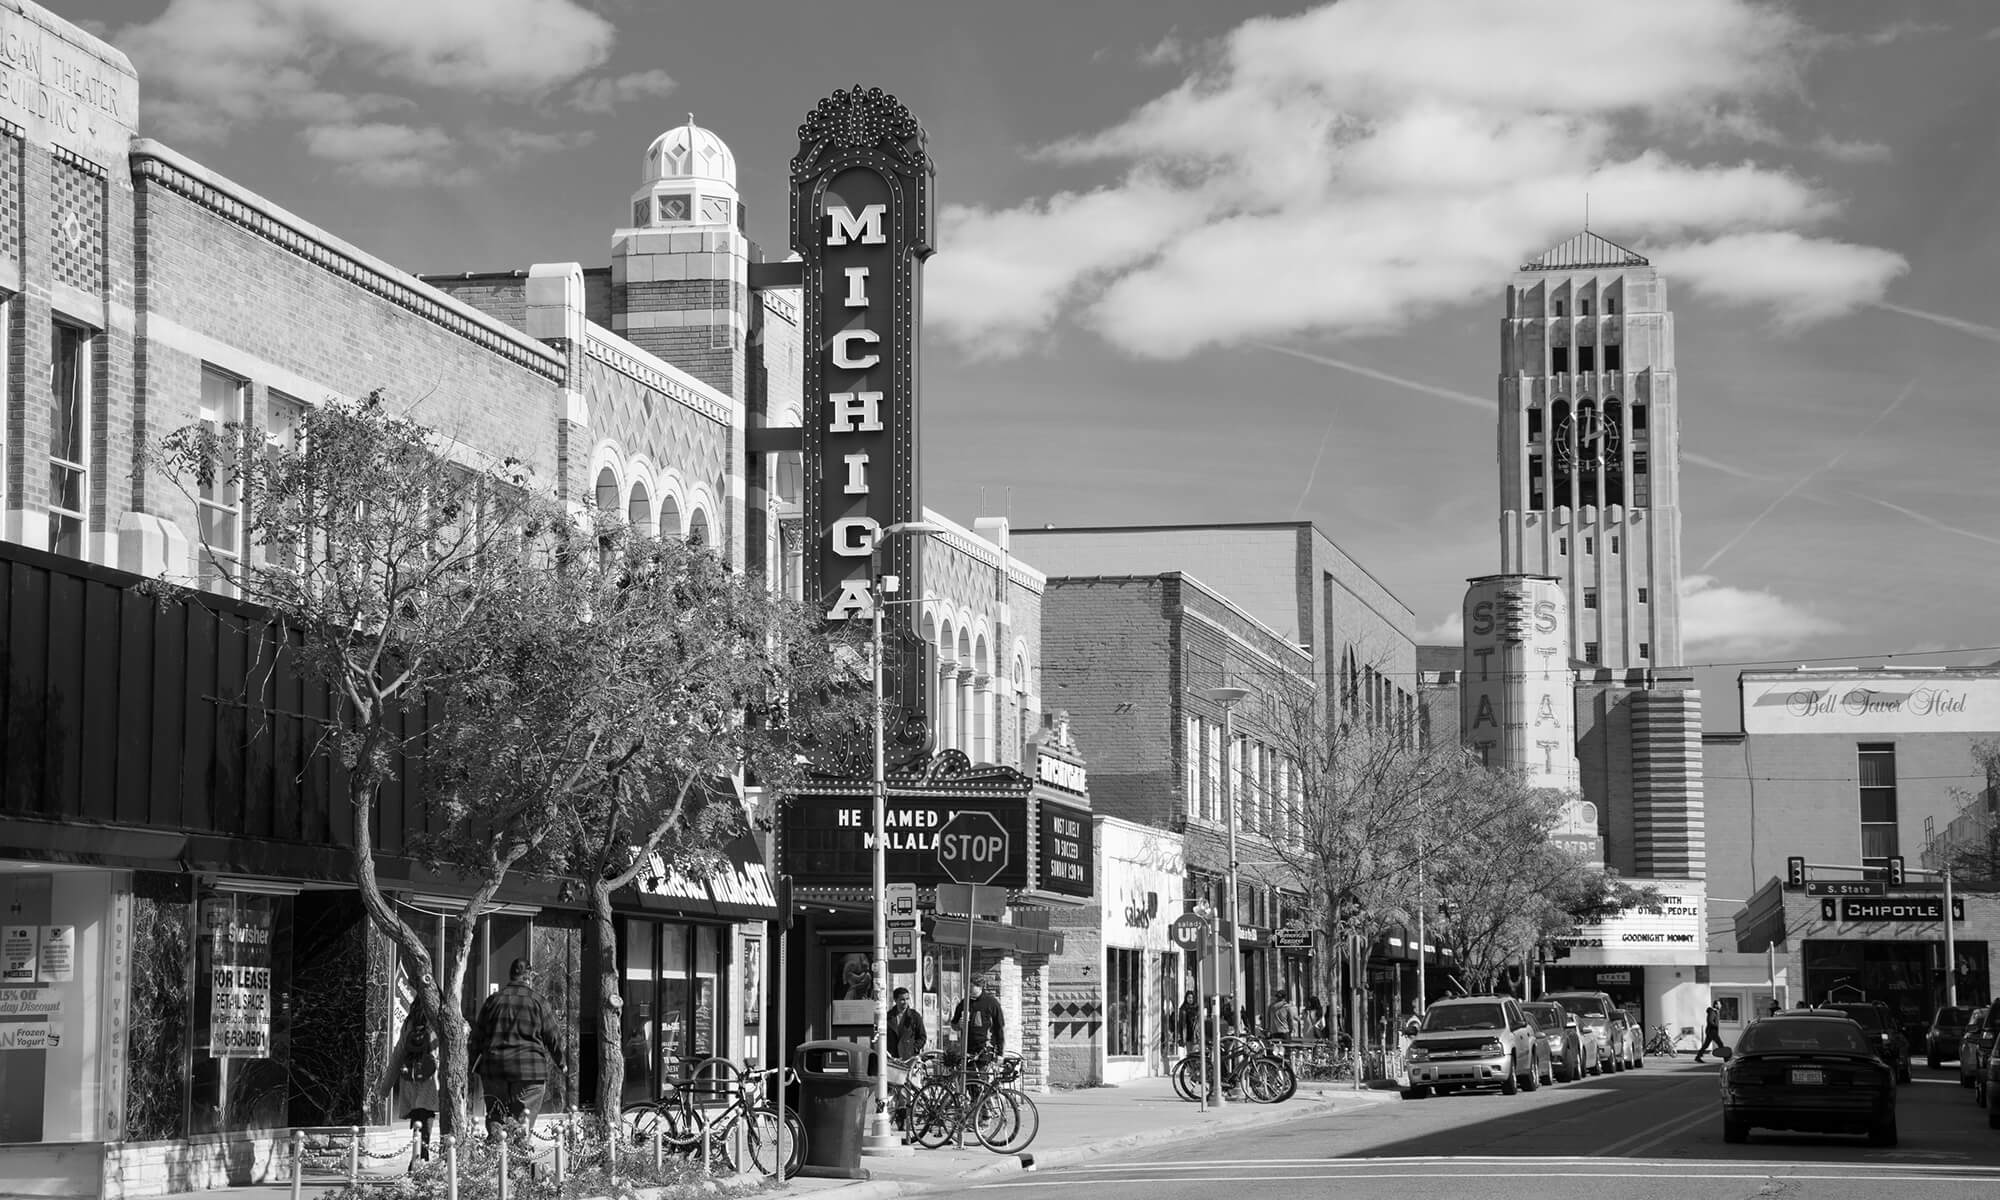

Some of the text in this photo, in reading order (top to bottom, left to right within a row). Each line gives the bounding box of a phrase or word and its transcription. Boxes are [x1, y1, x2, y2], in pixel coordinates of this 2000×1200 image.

[53, 55, 119, 117] THEATER
[1786, 686, 1967, 717] Bell Tower Hotel
[838, 809, 862, 827] HE
[873, 810, 939, 827] AMED
[863, 832, 939, 850] MALALA
[943, 834, 1003, 863] STOP
[1827, 884, 1871, 895] S. State
[1667, 907, 1698, 916] PEOPLE
[1848, 903, 1939, 917] CHIPOTLE
[228, 921, 269, 945] Swisher
[1622, 933, 1695, 943] GOODNIGHT MOMMY
[214, 970, 269, 989] FOR LEASE
[20, 989, 39, 1001] Off
[216, 993, 241, 1010] RETAIL
[243, 993, 265, 1010] SPACE
[19, 1000, 61, 1013] Discount
[16, 1028, 46, 1037] Frozen
[17, 1037, 46, 1048] Yogurt
